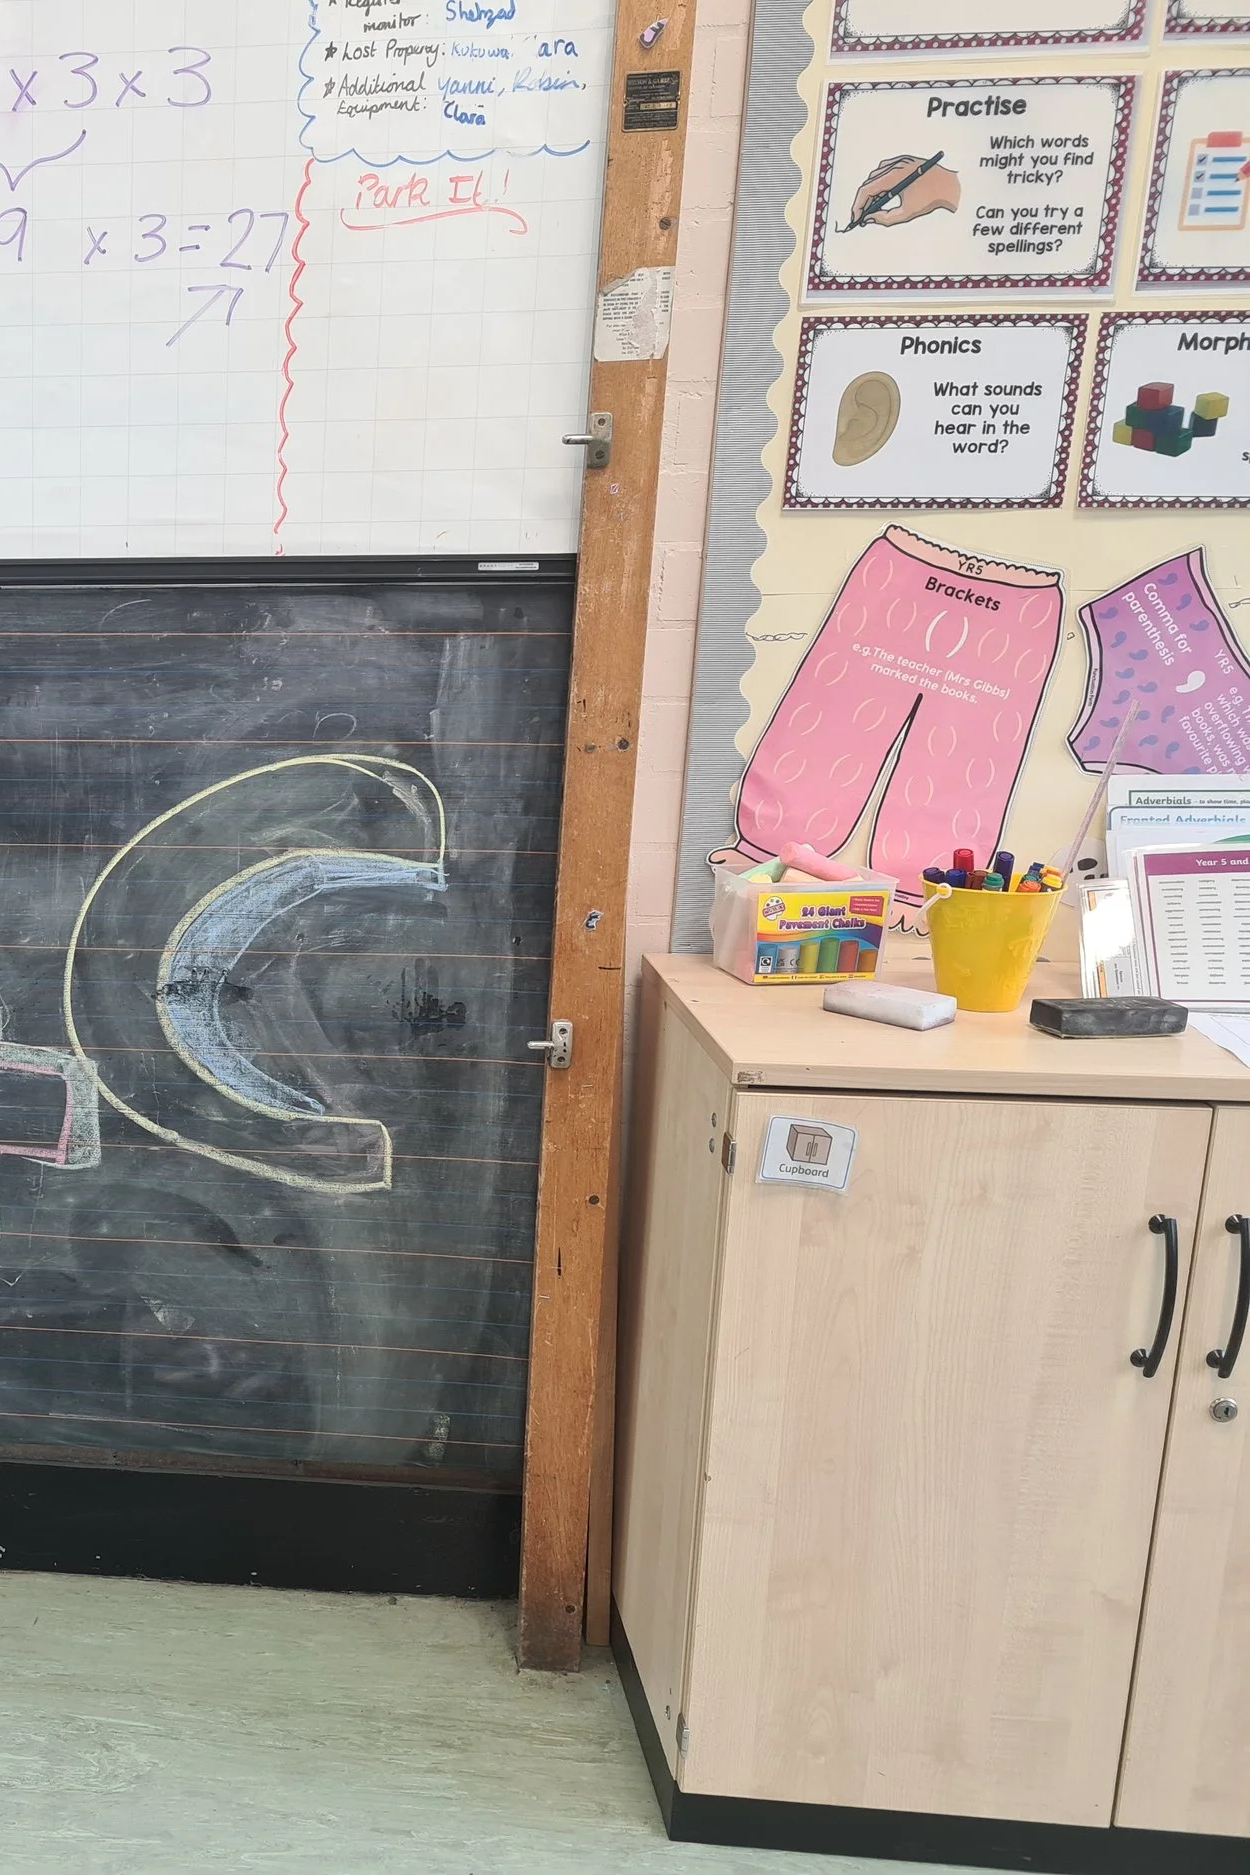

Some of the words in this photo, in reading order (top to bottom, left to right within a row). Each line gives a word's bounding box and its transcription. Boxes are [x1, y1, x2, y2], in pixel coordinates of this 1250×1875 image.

[342, 41, 377, 61] Lost
[338, 71, 426, 98] Additional
[926, 96, 1027, 119] Practise
[989, 135, 1035, 150] Which
[1039, 133, 1089, 149] words
[979, 151, 1024, 170] might
[1030, 154, 1058, 170] you
[1062, 151, 1094, 167] find
[1006, 169, 1063, 186] tricky?
[355, 172, 430, 212] Park
[975, 205, 1005, 220] Can
[1010, 207, 1039, 222] you
[1043, 204, 1069, 221] try
[1074, 206, 1084, 218] a
[972, 222, 1005, 237] few
[1010, 221, 1083, 236] different
[987, 238, 1063, 256] spellings?
[900, 336, 982, 356] Phonics
[933, 381, 979, 397] What
[983, 381, 1043, 397] sounds
[951, 403, 982, 416] can
[989, 402, 1020, 418] you
[934, 420, 977, 436] hear
[982, 419, 996, 435] in
[1003, 420, 1031, 435] the
[952, 438, 1009, 455] word?
[957, 559, 984, 576] YR5
[924, 576, 1002, 612] Brackets
[1143, 582, 1179, 635] Comma
[1176, 632, 1192, 655] for
[1122, 591, 1175, 667] parenthesis
[1213, 648, 1235, 676] YR5
[870, 661, 918, 685] marked
[918, 677, 939, 691] the
[940, 683, 979, 704] books.
[897, 656, 943, 677] teacher
[945, 669, 971, 687] (Mrs
[973, 678, 1011, 700] Gibbs)
[1216, 693, 1240, 728] which
[1179, 715, 1213, 766] favourite
[1191, 707, 1215, 746] books,
[1213, 743, 1231, 767] was
[1204, 701, 1246, 767] overflowing
[1135, 796, 1192, 805] Adverbials
[1195, 859, 1218, 867] Year
[1221, 858, 1227, 866] 5
[1230, 857, 1249, 865] and
[818, 906, 846, 917] Giant
[779, 920, 830, 930] Pavement
[832, 917, 866, 929] Chalks
[779, 1163, 830, 1178] Cupboard
